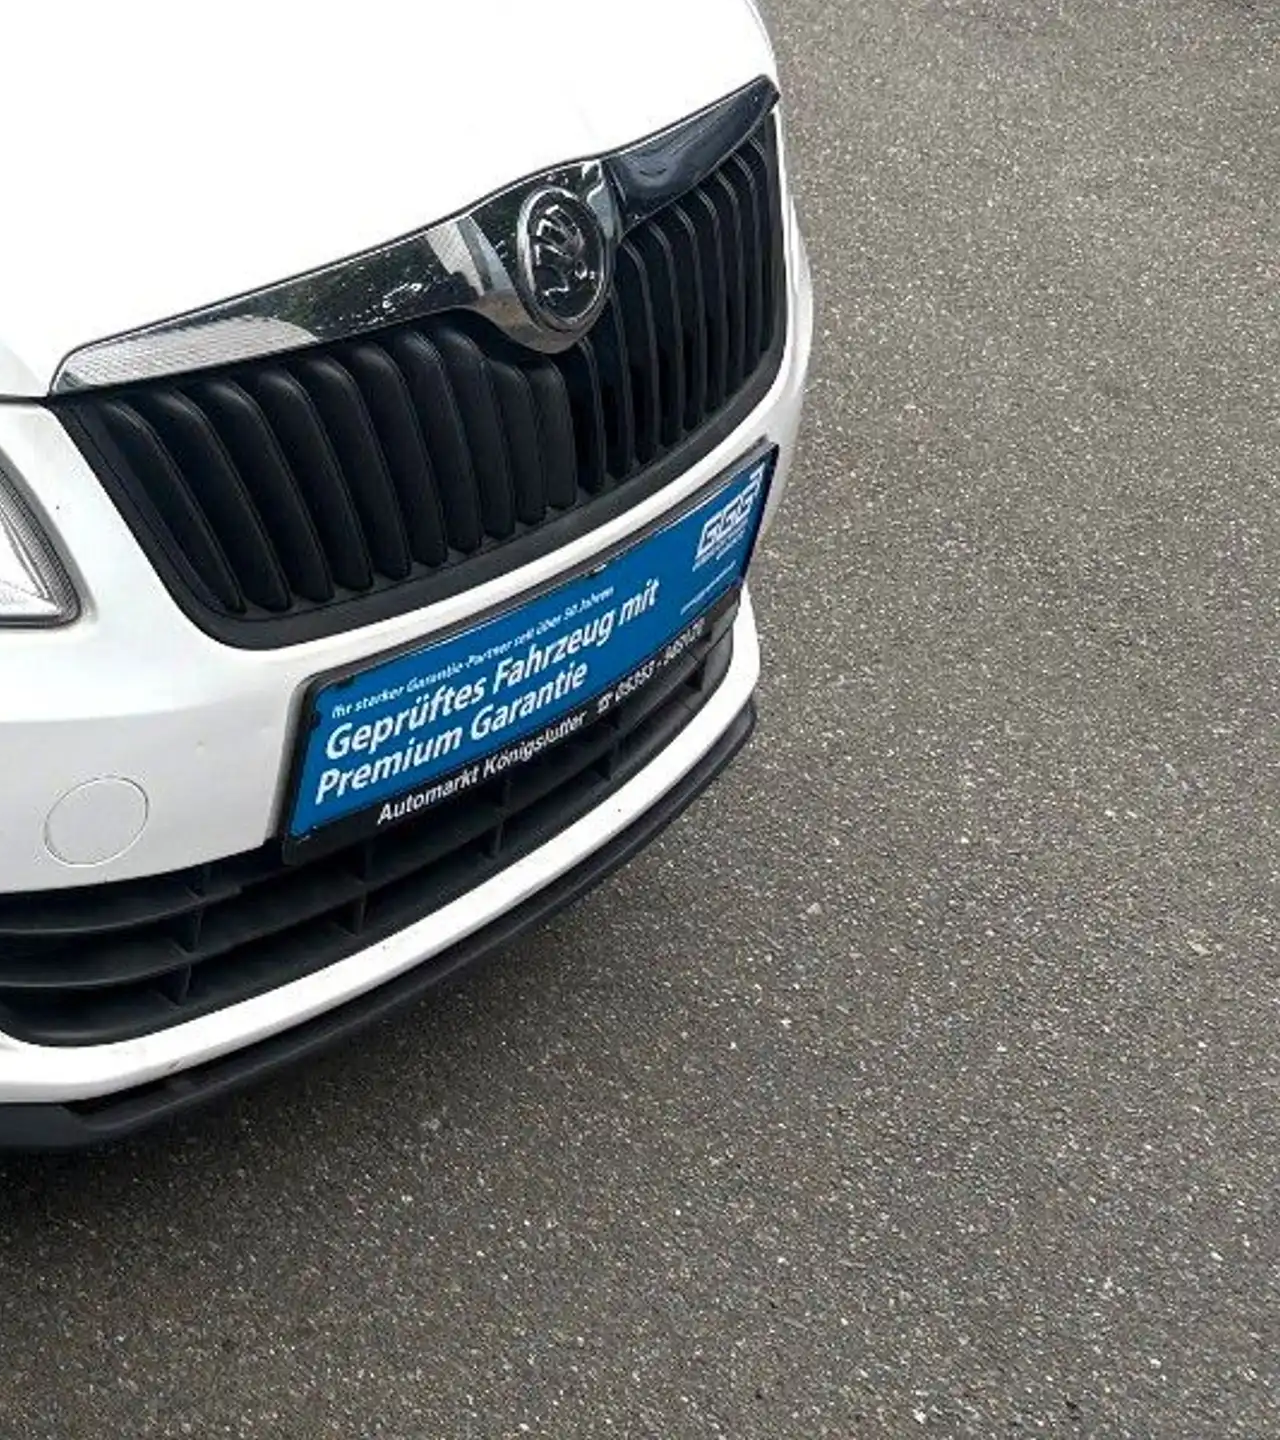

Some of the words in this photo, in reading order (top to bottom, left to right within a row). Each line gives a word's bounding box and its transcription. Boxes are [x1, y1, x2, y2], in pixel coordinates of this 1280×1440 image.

[315, 725, 464, 805] Premium
[470, 661, 588, 742] Garantie
[326, 676, 488, 760] Geprüftes
[492, 608, 616, 695] Fahrzeug
[618, 576, 660, 628] mit
[376, 762, 480, 826] Automarkt
[482, 710, 588, 779] Königslutter
